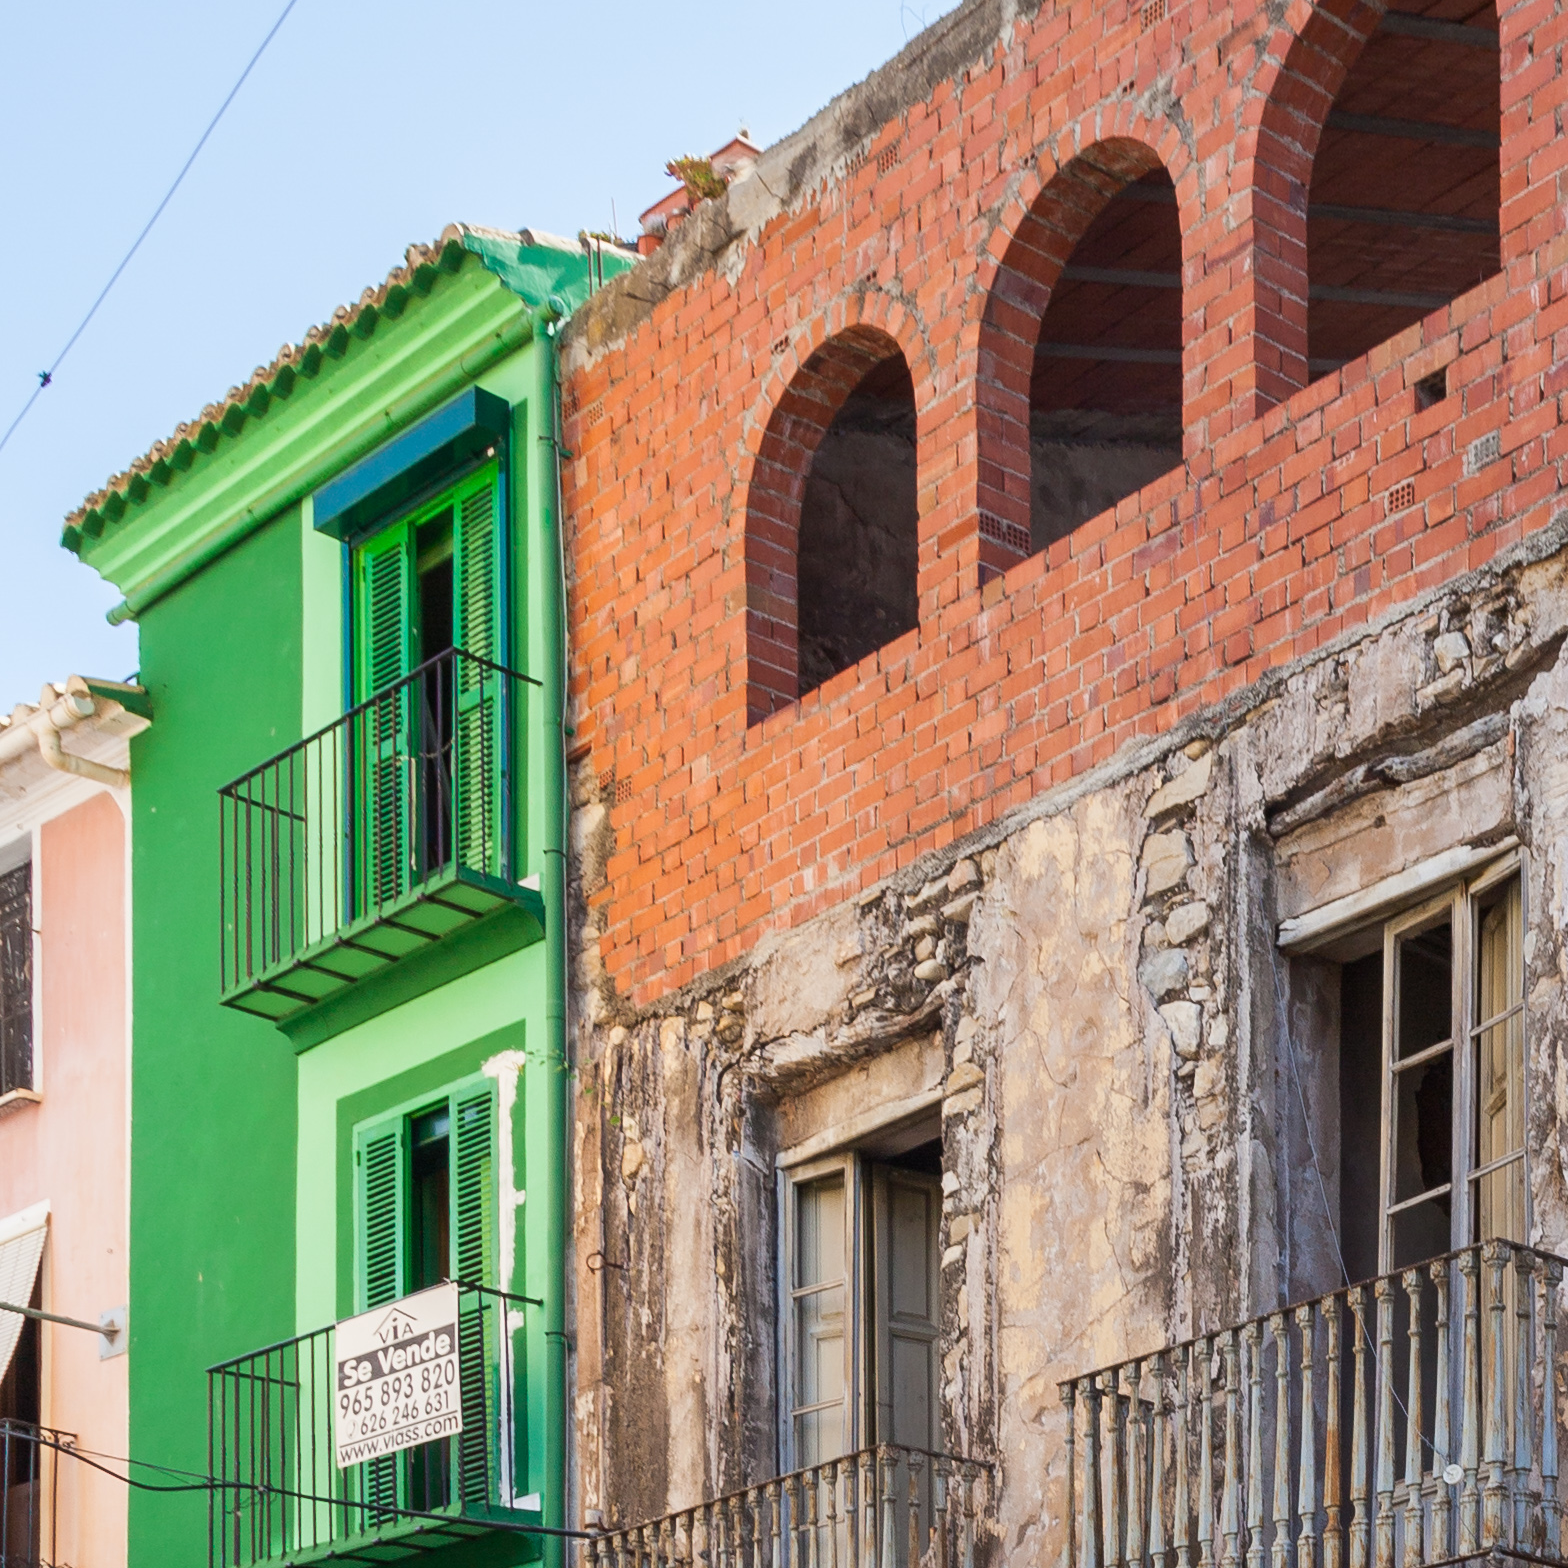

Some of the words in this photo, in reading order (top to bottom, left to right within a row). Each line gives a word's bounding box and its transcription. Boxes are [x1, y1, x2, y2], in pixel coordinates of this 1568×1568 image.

[343, 1359, 373, 1387] Se
[378, 1331, 450, 1375] Vende
[340, 1386, 373, 1419] 965
[381, 1373, 414, 1407] 893
[421, 1359, 455, 1393] 820
[360, 1410, 387, 1436] 626
[392, 1400, 419, 1426] 246
[425, 1390, 450, 1414] 631
[340, 1414, 459, 1463] www.viass.com
